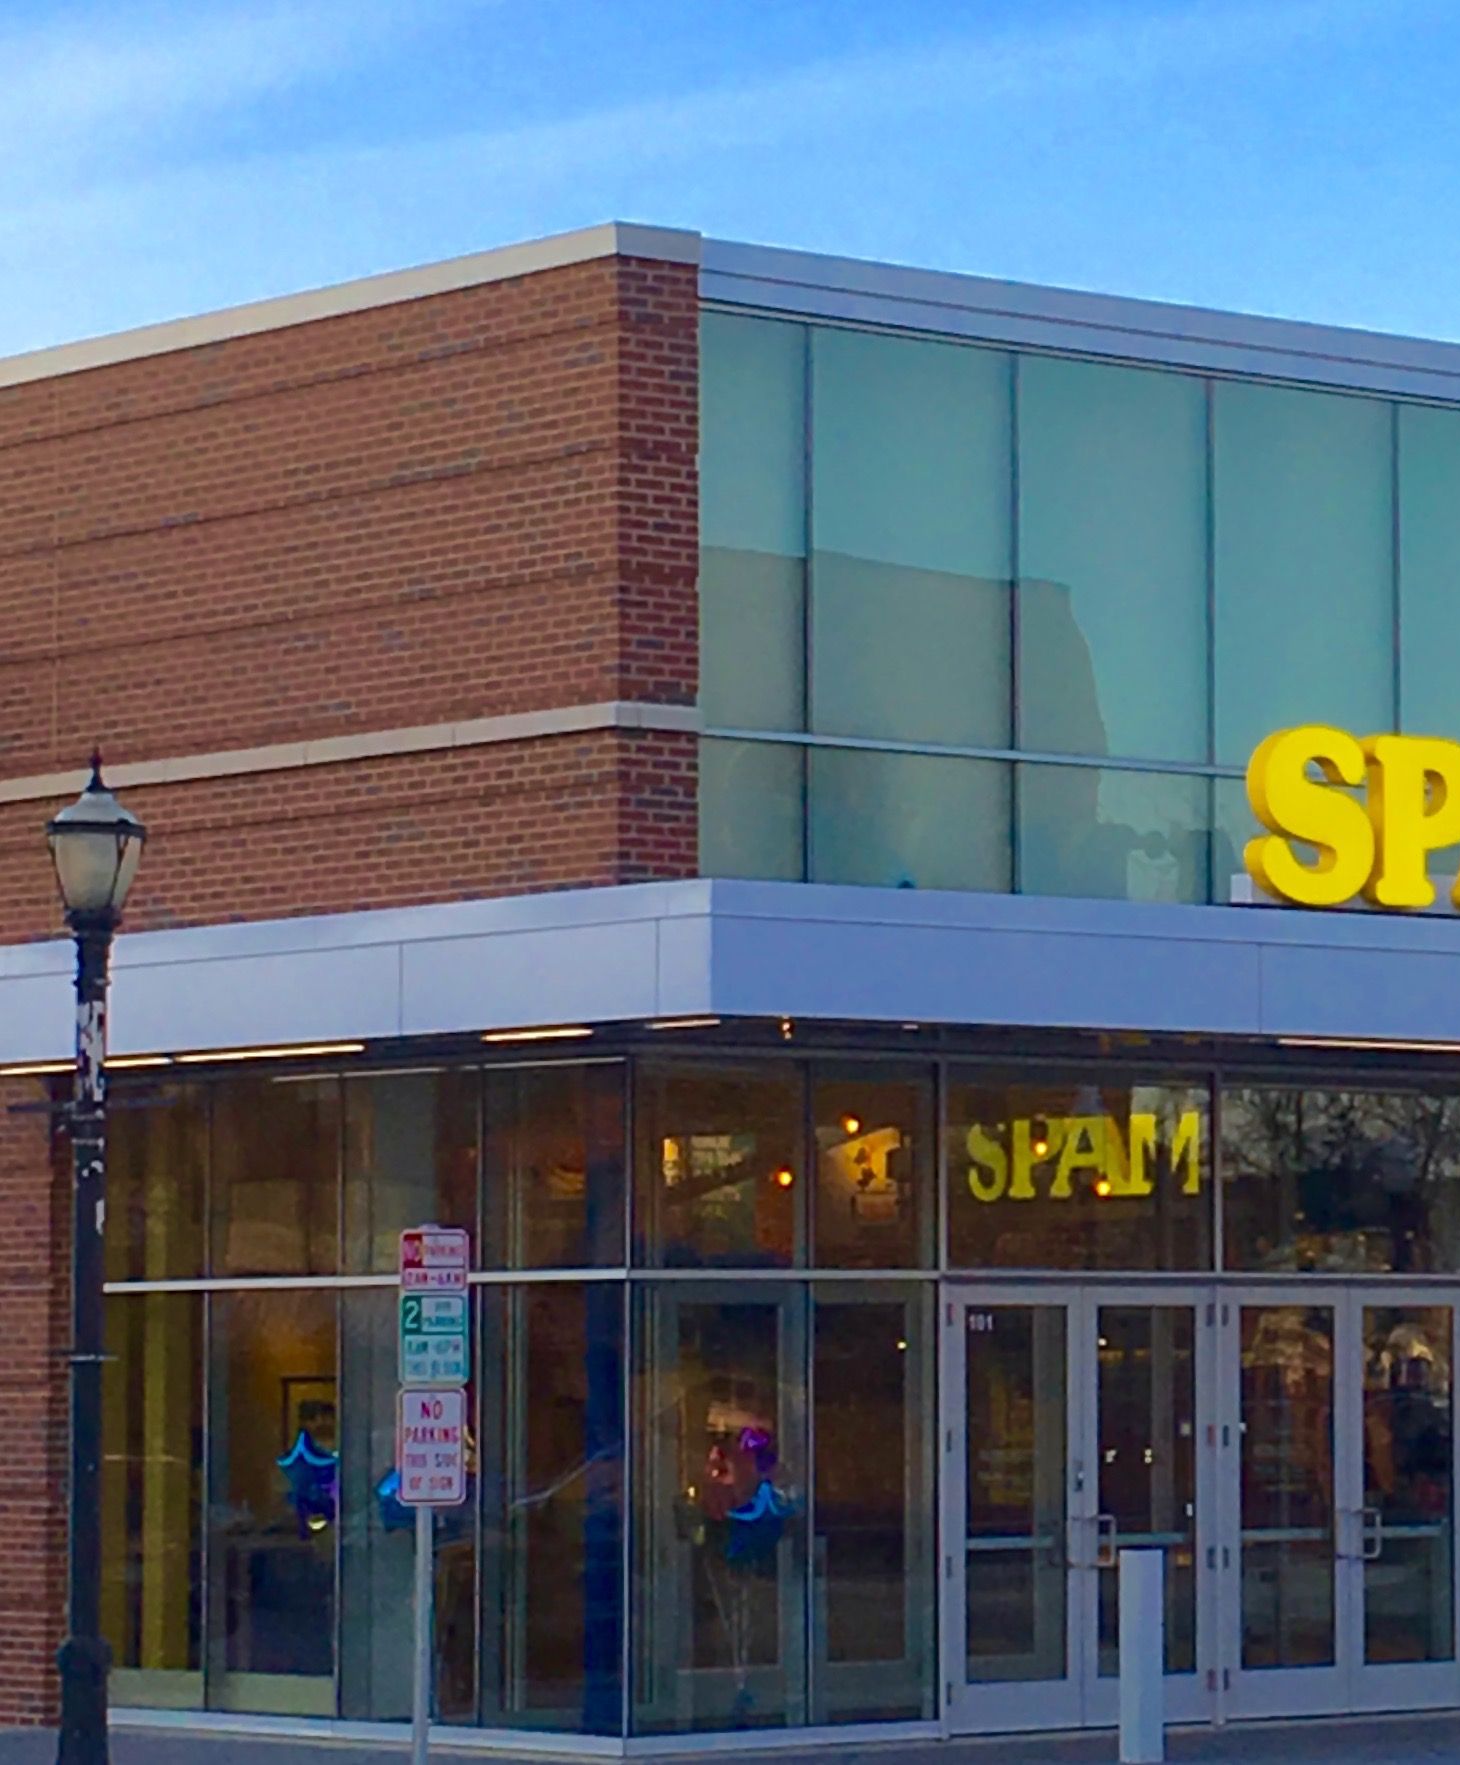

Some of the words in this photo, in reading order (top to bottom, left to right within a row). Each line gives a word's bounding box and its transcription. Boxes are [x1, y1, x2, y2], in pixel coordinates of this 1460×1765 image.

[967, 1111, 1200, 1202] SPAM
[405, 1301, 419, 1328] 2
[969, 1313, 993, 1331] 101
[421, 1400, 443, 1420] NO
[404, 1426, 459, 1443] PARKING
